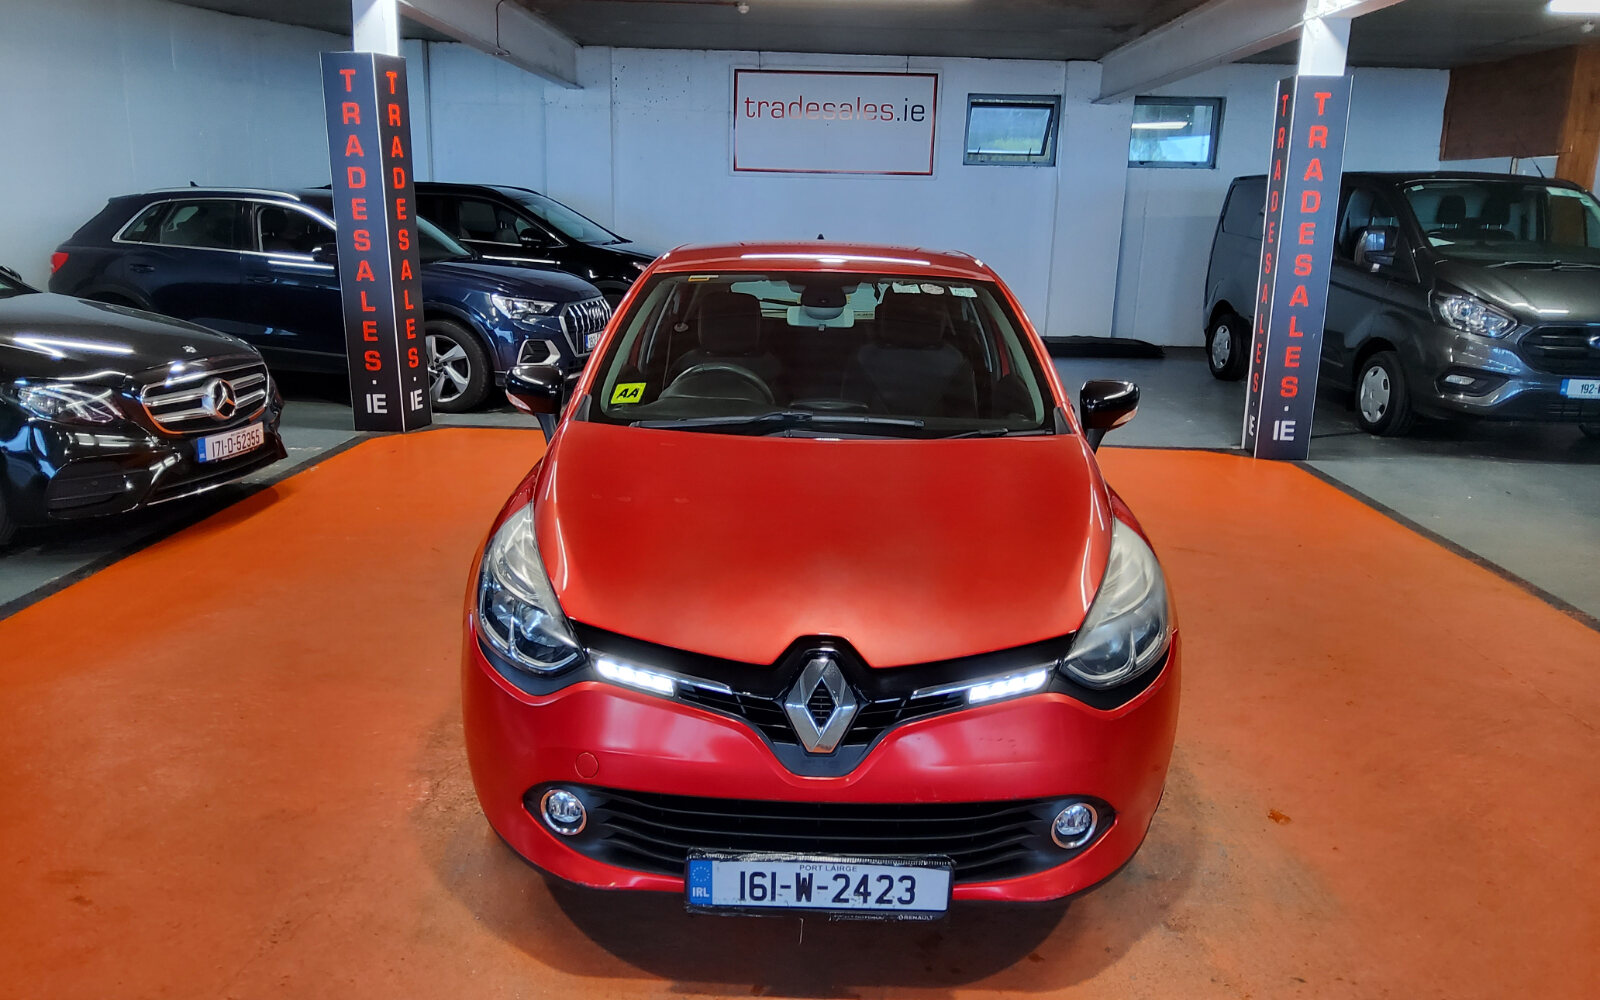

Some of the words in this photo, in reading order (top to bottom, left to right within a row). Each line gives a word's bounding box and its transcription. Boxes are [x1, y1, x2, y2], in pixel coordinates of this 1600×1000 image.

[744, 95, 925, 122] tradesales.ie
[616, 387, 640, 399] AA
[212, 429, 261, 458] 171-D-52355
[692, 886, 710, 898] IRL
[740, 871, 916, 905] 161-W-2423
